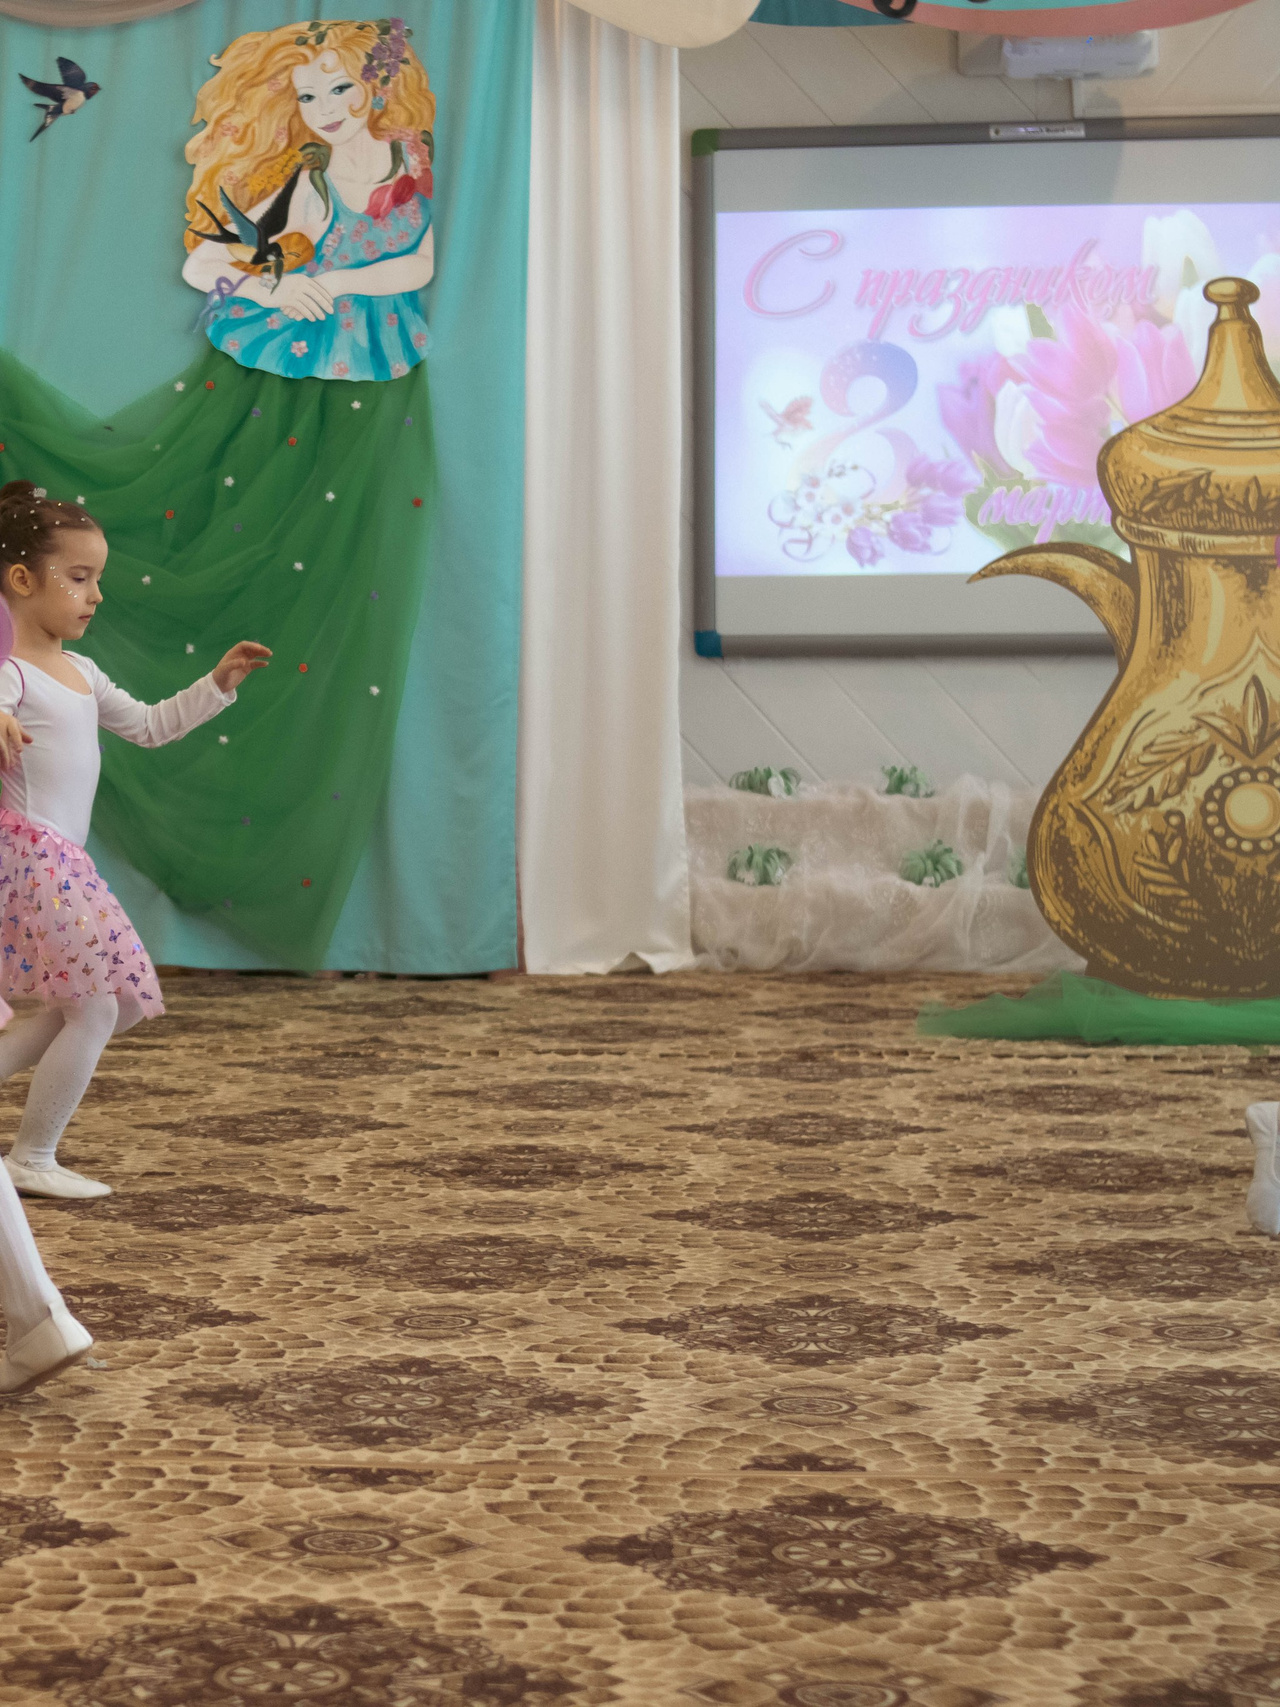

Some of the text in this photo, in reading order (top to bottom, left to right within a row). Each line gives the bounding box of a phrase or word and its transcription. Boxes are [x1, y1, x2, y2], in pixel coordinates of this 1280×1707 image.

[743, 229, 1160, 340] С праздником
[977, 485, 1113, 545] март
